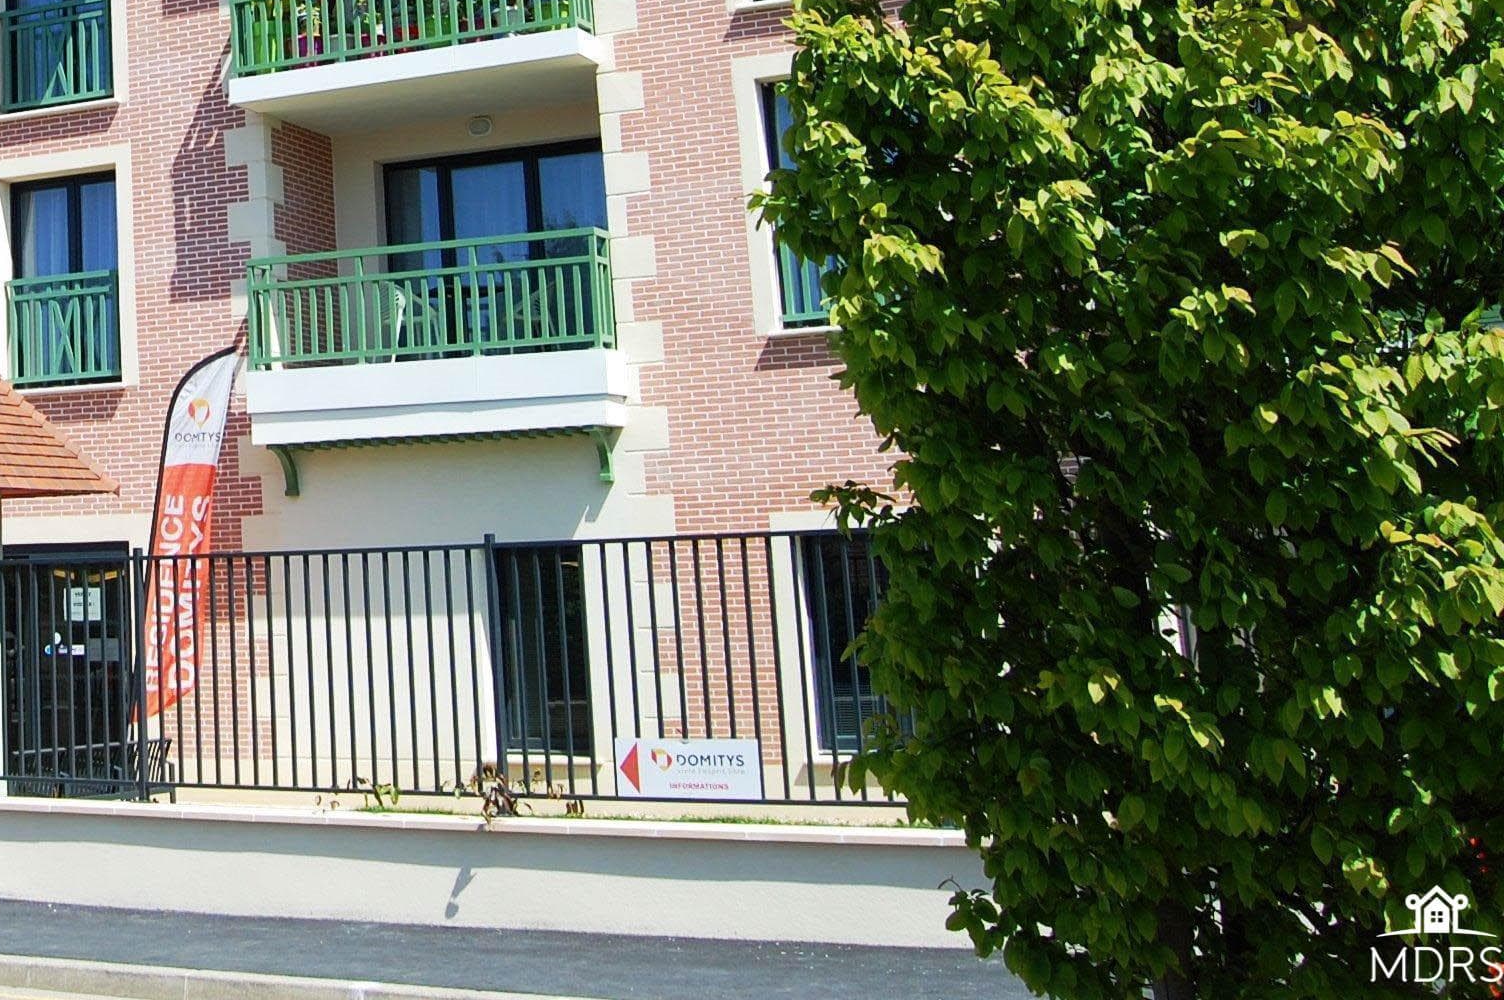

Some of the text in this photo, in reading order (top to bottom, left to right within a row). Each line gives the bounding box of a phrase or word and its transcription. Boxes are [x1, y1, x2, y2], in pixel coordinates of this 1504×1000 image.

[175, 432, 221, 442] DOMTYS
[168, 495, 209, 690] DOMITYS
[676, 754, 745, 767] DOMITYS
